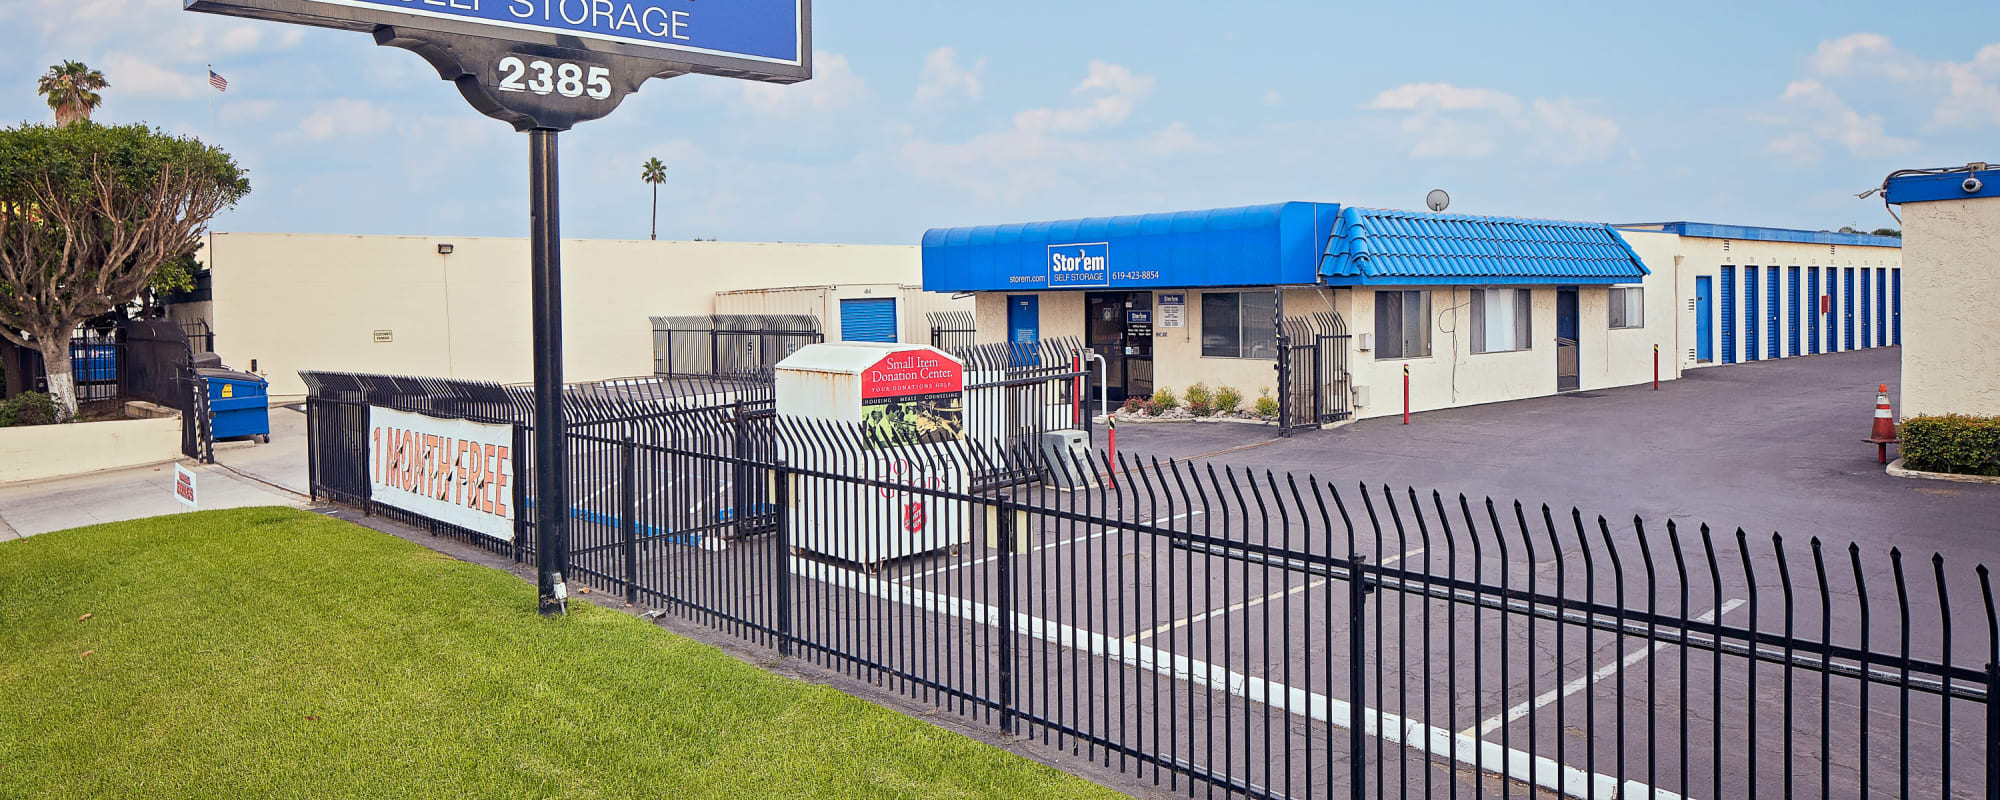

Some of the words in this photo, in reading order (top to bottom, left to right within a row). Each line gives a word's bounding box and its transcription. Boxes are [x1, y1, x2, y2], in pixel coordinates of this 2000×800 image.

[508, 0, 690, 40] STORAGE
[498, 56, 612, 100] 2385
[1053, 249, 1105, 272] Stor'em
[1009, 275, 1046, 283] storem.com
[1054, 273, 1070, 282] SELF
[1071, 272, 1104, 281] STORAGE
[1112, 271, 1160, 280] 619-423-8854
[886, 356, 914, 370] Small
[917, 356, 939, 368] Item
[872, 369, 918, 383] Donation
[920, 368, 953, 379] Center.
[892, 383, 933, 391] DONATIONS
[924, 392, 958, 400] COUNSELING
[373, 427, 381, 483] 1
[385, 427, 452, 502] MONTH
[455, 439, 509, 517] FREE
